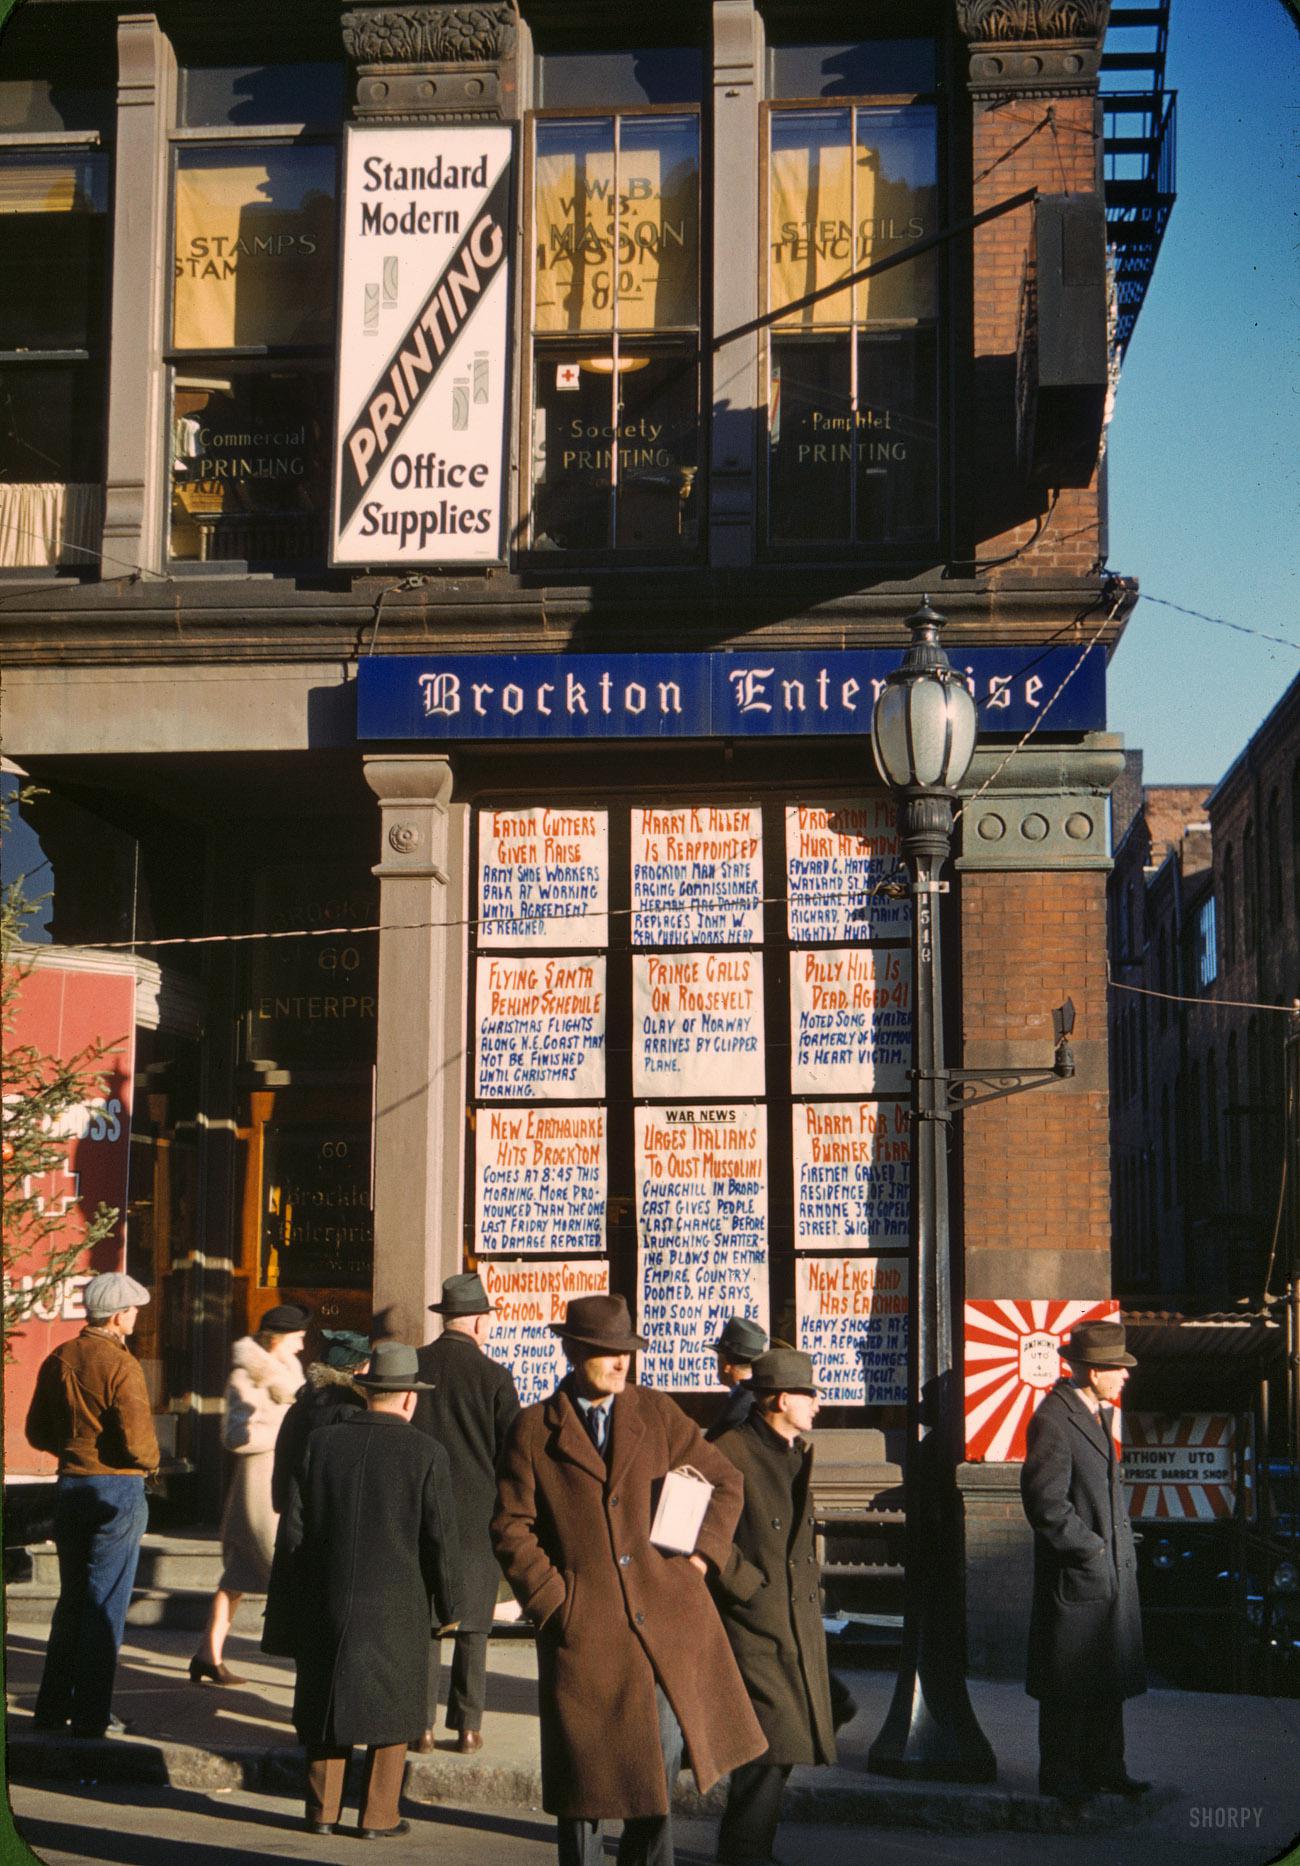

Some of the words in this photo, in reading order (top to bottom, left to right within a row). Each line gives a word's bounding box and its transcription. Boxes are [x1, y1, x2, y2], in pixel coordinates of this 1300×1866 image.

[363, 154, 488, 192] Standard
[360, 202, 460, 237] Modern
[551, 221, 684, 252] MASON
[782, 218, 924, 242] STENCILS
[191, 233, 317, 257] STAMPS
[350, 215, 504, 487] PRINTING
[200, 425, 305, 447] Commercial
[571, 418, 663, 441] Society
[564, 449, 669, 469] PRINTING
[799, 443, 906, 463] PRINTING
[201, 458, 303, 478] PRINTING
[390, 454, 489, 490] Office
[360, 501, 491, 550] Supplies
[418, 672, 682, 717] Brockton
[729, 667, 1043, 713] Enterise
[493, 810, 536, 838] EATON
[543, 808, 596, 836] CUTTERS
[642, 808, 685, 834] HARRY
[709, 806, 750, 832] ALLEN
[498, 841, 536, 864] GIVEN
[545, 838, 581, 863] RAISE
[667, 837, 758, 861] REAPPOINTED
[800, 834, 832, 857] HURT
[484, 865, 513, 882] ARMY
[518, 866, 540, 882] SHOE
[546, 865, 599, 882] WORKERS
[634, 864, 686, 880] BROCKTON
[692, 862, 715, 879] MAN
[721, 862, 750, 878] STATE
[790, 859, 829, 875] EDWARD
[539, 884, 598, 899] WORKING
[635, 883, 675, 896] RACING
[789, 876, 842, 890] WAYLAND
[483, 903, 514, 918] UNTIL
[521, 901, 588, 918] AGREEMENT
[635, 914, 690, 928] REPLACES
[489, 962, 538, 990] FLYING
[545, 961, 593, 988] SANTA
[648, 958, 698, 984] PRINCE
[706, 956, 750, 982] CALLS
[806, 954, 844, 982] BILLY
[848, 952, 876, 981] HILL
[492, 992, 539, 1016] BEHIND
[541, 990, 602, 1015] SCHEDULE
[652, 987, 670, 1012] ON
[679, 985, 753, 1011] ROOSEVELT
[853, 983, 889, 1009] AGED
[892, 982, 908, 1008] 41
[260, 997, 374, 1018] ENTERPR
[481, 1017, 542, 1034] CHRISTMAS
[548, 1017, 593, 1032] FLIGHTS
[644, 1016, 675, 1034] OLAV
[702, 1014, 751, 1032] NORWAY
[800, 1011, 834, 1028] NOTED
[836, 1010, 865, 1027] SONG
[481, 1037, 516, 1051] ALONG
[544, 1035, 579, 1050] COAST
[583, 1034, 604, 1048] MAY
[645, 1038, 689, 1053] ARRIVES
[696, 1038, 710, 1052] BY
[714, 1036, 757, 1052] CLIPPER
[800, 1031, 856, 1047] FORMERLY
[481, 1054, 502, 1066] NOT
[531, 1051, 584, 1066] FINISHED
[814, 1049, 853, 1064] HEART
[480, 1068, 508, 1082] UNTIL
[514, 1068, 576, 1081] CHRISTMAS
[666, 1111, 694, 1121] WAR
[700, 1110, 736, 1120] NEWS
[806, 1107, 852, 1134] ALARM
[859, 1104, 888, 1134] FOR
[491, 1112, 522, 1140] NEW
[526, 1111, 603, 1139] EARTHQUAKE
[644, 1124, 686, 1150] URGES
[693, 1124, 756, 1150] ITALIANS
[322, 1142, 348, 1158] 60
[497, 1142, 527, 1166] HITS
[533, 1140, 600, 1166] BROCKTON
[812, 1137, 869, 1162] BURNER
[484, 1165, 519, 1183] COMES
[542, 1167, 572, 1181] 8:45
[577, 1166, 599, 1181] THIS
[645, 1154, 662, 1178] TO
[668, 1152, 700, 1178] OUST
[703, 1152, 761, 1178] MUSSOLINI
[801, 1163, 848, 1182] FIREMEN
[855, 1164, 895, 1181] CALLED
[540, 1184, 568, 1200] MORE
[643, 1180, 706, 1197] CHURCHILL
[800, 1184, 864, 1200] RESIDENCE
[484, 1203, 531, 1217] NOUNCED
[534, 1202, 564, 1216] THAN
[568, 1202, 585, 1216] THE
[588, 1201, 604, 1215] ONE
[642, 1200, 670, 1215] CAST
[676, 1200, 710, 1214] GIVES
[717, 1199, 754, 1214] PEOPLE
[800, 1202, 848, 1218] ARNONE
[481, 1219, 506, 1233] LAST
[511, 1218, 548, 1232] FRIDAY
[732, 1216, 764, 1231] BEFORE
[844, 1219, 879, 1235] SLIGHT
[502, 1234, 545, 1249] DAMAGE
[644, 1235, 709, 1248] LAUNCHING
[670, 1250, 708, 1265] BLOWS
[487, 1264, 560, 1293] COUNSELORS
[562, 1264, 607, 1291] CRITICIZE
[696, 1267, 750, 1282] COUNTRY
[809, 1264, 838, 1291] NEW
[842, 1262, 900, 1291] ENGLAND
[495, 1296, 544, 1321] SCHOOL
[644, 1304, 666, 1318] AND
[670, 1304, 702, 1318] SOON
[744, 1304, 759, 1319] BE
[820, 1293, 848, 1314] HAS
[643, 1322, 696, 1336] OVERRUN
[801, 1315, 837, 1332] HEAVY
[841, 1318, 881, 1332] SHOCKS
[831, 1334, 880, 1349] REPORTED
[514, 1344, 555, 1358] SHOULD
[522, 1361, 557, 1374] GIVEN
[532, 1376, 548, 1390] FOR
[672, 1373, 699, 1386] HINTS
[821, 1388, 863, 1400] SERIOUS
[1123, 1452, 1176, 1464] NTHONY
[1189, 1452, 1215, 1464] UTO
[1162, 1470, 1198, 1479] BARBER
[1203, 1470, 1228, 1479] SHOP
